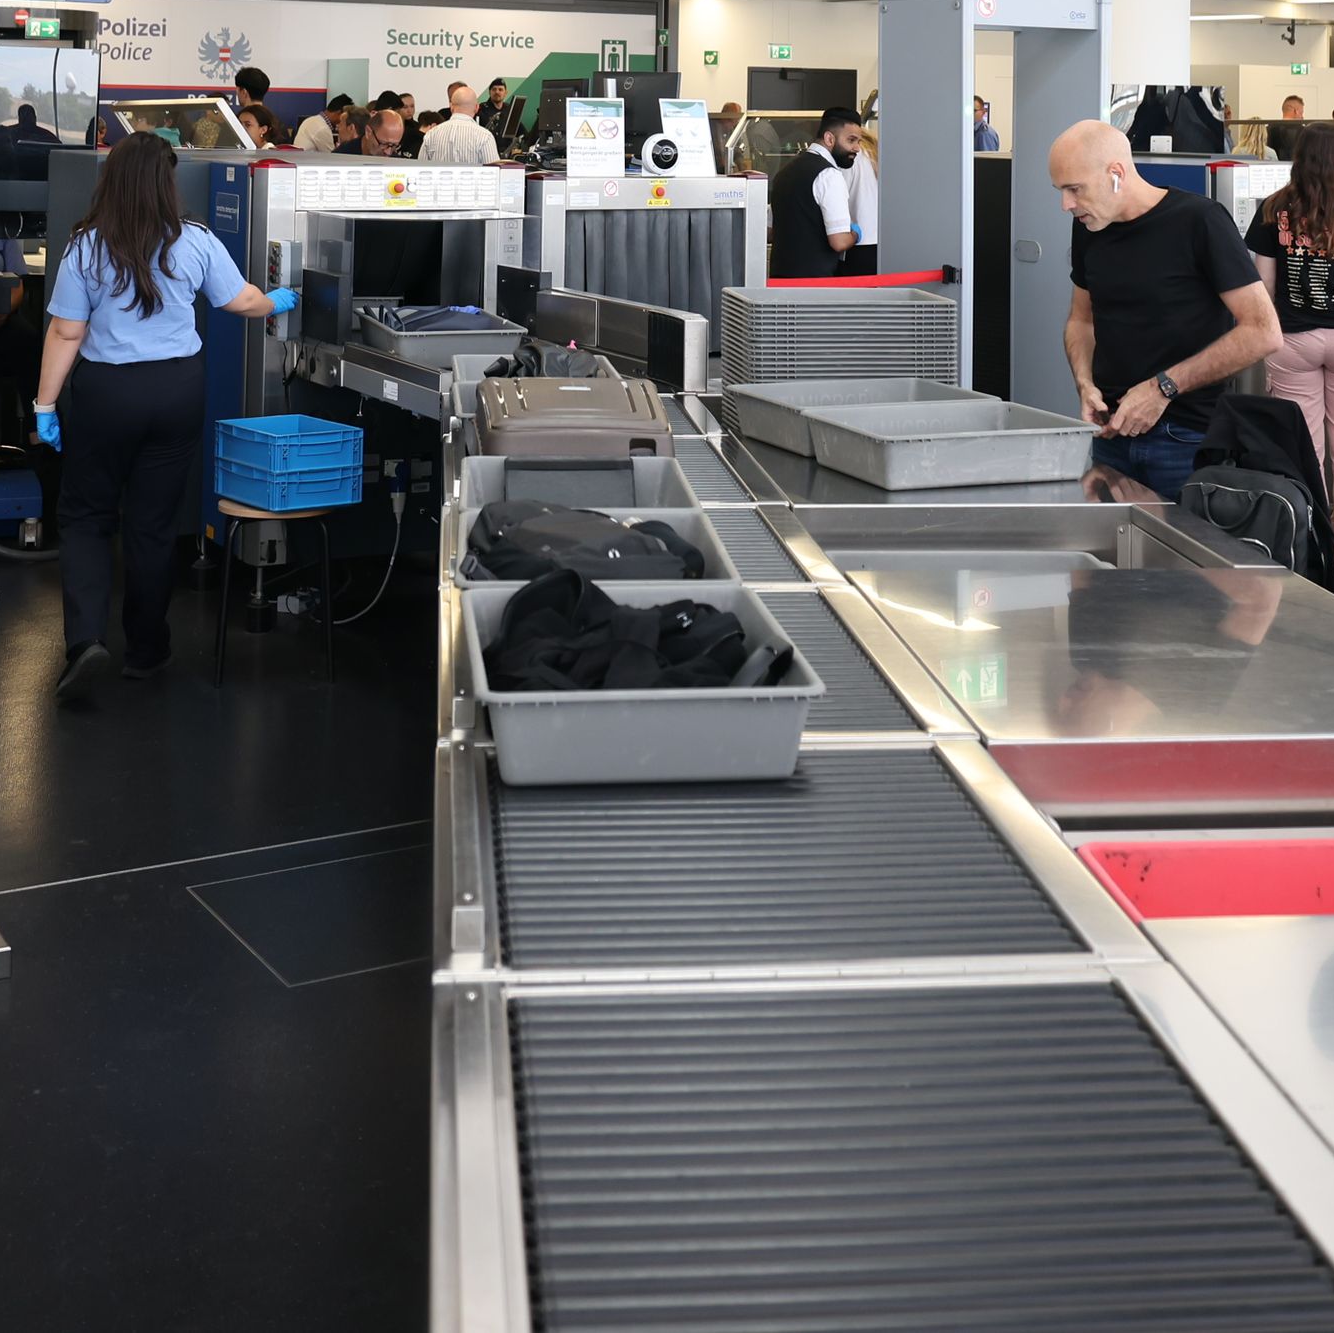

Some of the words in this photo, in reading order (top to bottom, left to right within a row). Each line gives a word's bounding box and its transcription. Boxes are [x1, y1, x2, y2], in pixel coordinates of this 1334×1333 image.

[98, 18, 167, 37] Polizei
[386, 28, 465, 51] Security
[469, 31, 535, 49] Service
[99, 42, 153, 60] Police
[386, 51, 463, 69] Counter
[714, 190, 744, 199] smiths
